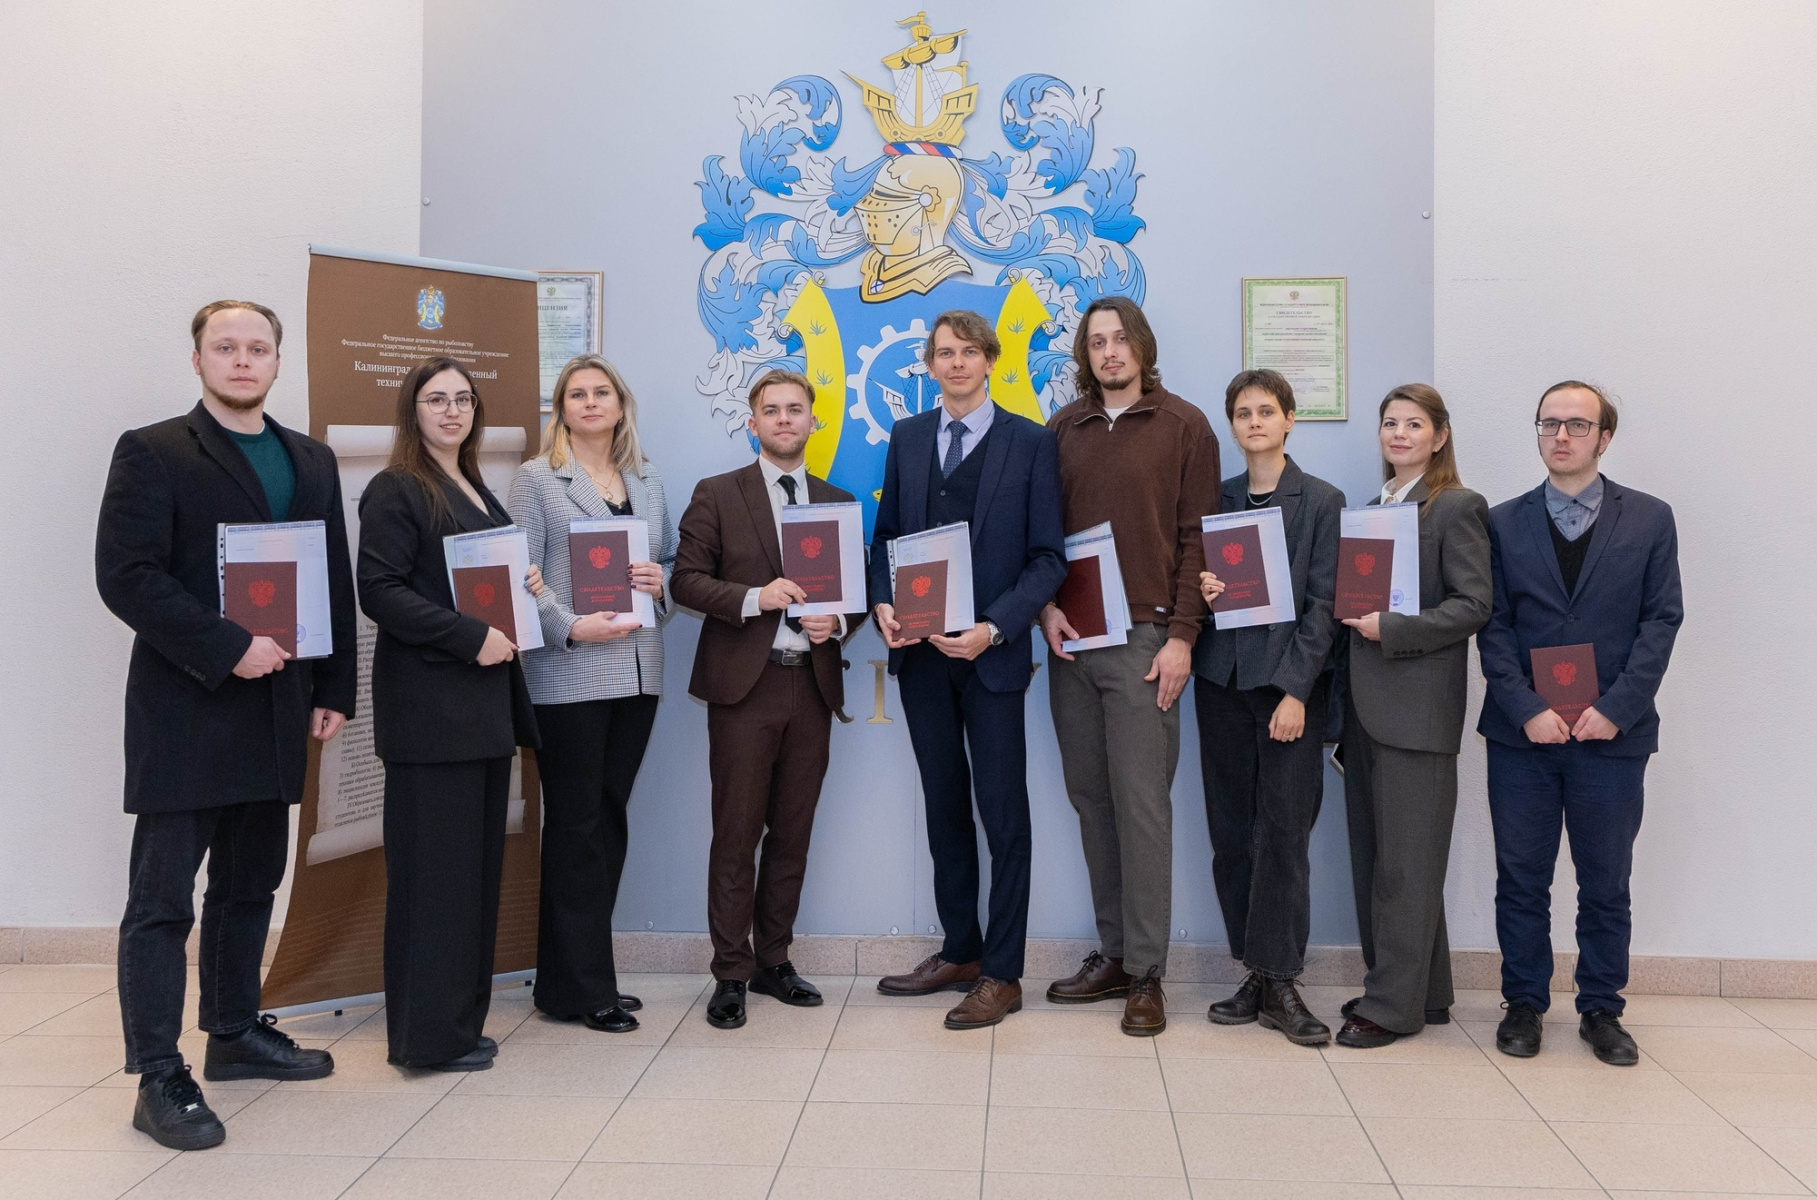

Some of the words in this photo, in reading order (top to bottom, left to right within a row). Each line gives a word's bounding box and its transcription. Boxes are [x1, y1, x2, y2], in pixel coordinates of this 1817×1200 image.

[341, 338, 376, 348] Федеральное
[377, 342, 417, 350] государственное
[417, 345, 444, 353] бюджетное
[444, 347, 481, 355] образовательное
[382, 333, 415, 343] Федеральное
[445, 340, 474, 349] рыболовству
[354, 360, 411, 376] Калининград
[580, 585, 624, 593] СВИДЕТЕЛЬСТВО
[900, 610, 940, 620] СВИДЕТЕЛЬСТВО
